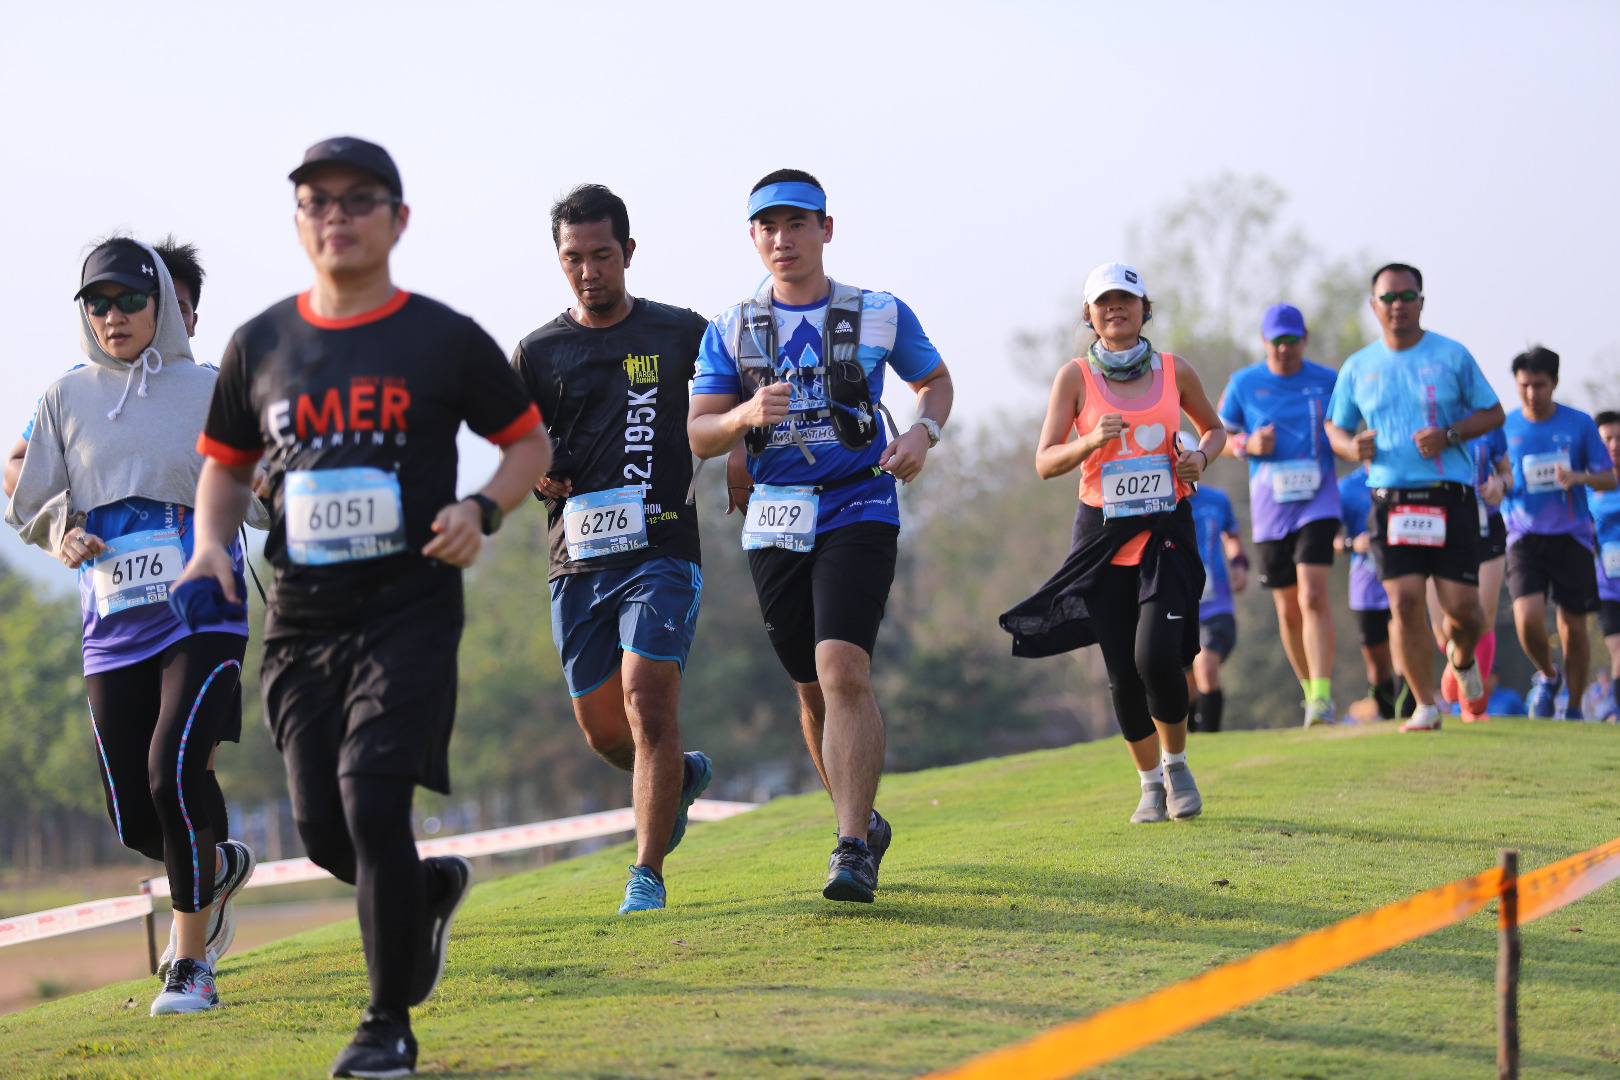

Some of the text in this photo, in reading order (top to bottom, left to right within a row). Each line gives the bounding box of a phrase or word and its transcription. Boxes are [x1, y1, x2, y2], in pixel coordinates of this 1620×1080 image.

[634, 355, 660, 371] HIT
[635, 370, 659, 378] TARGET
[1117, 428, 1133, 456] I
[1115, 474, 1161, 496] 6027
[309, 497, 375, 531] 6051
[580, 508, 628, 536] 6276
[757, 505, 802, 527] 6029
[112, 552, 164, 586] 6176
